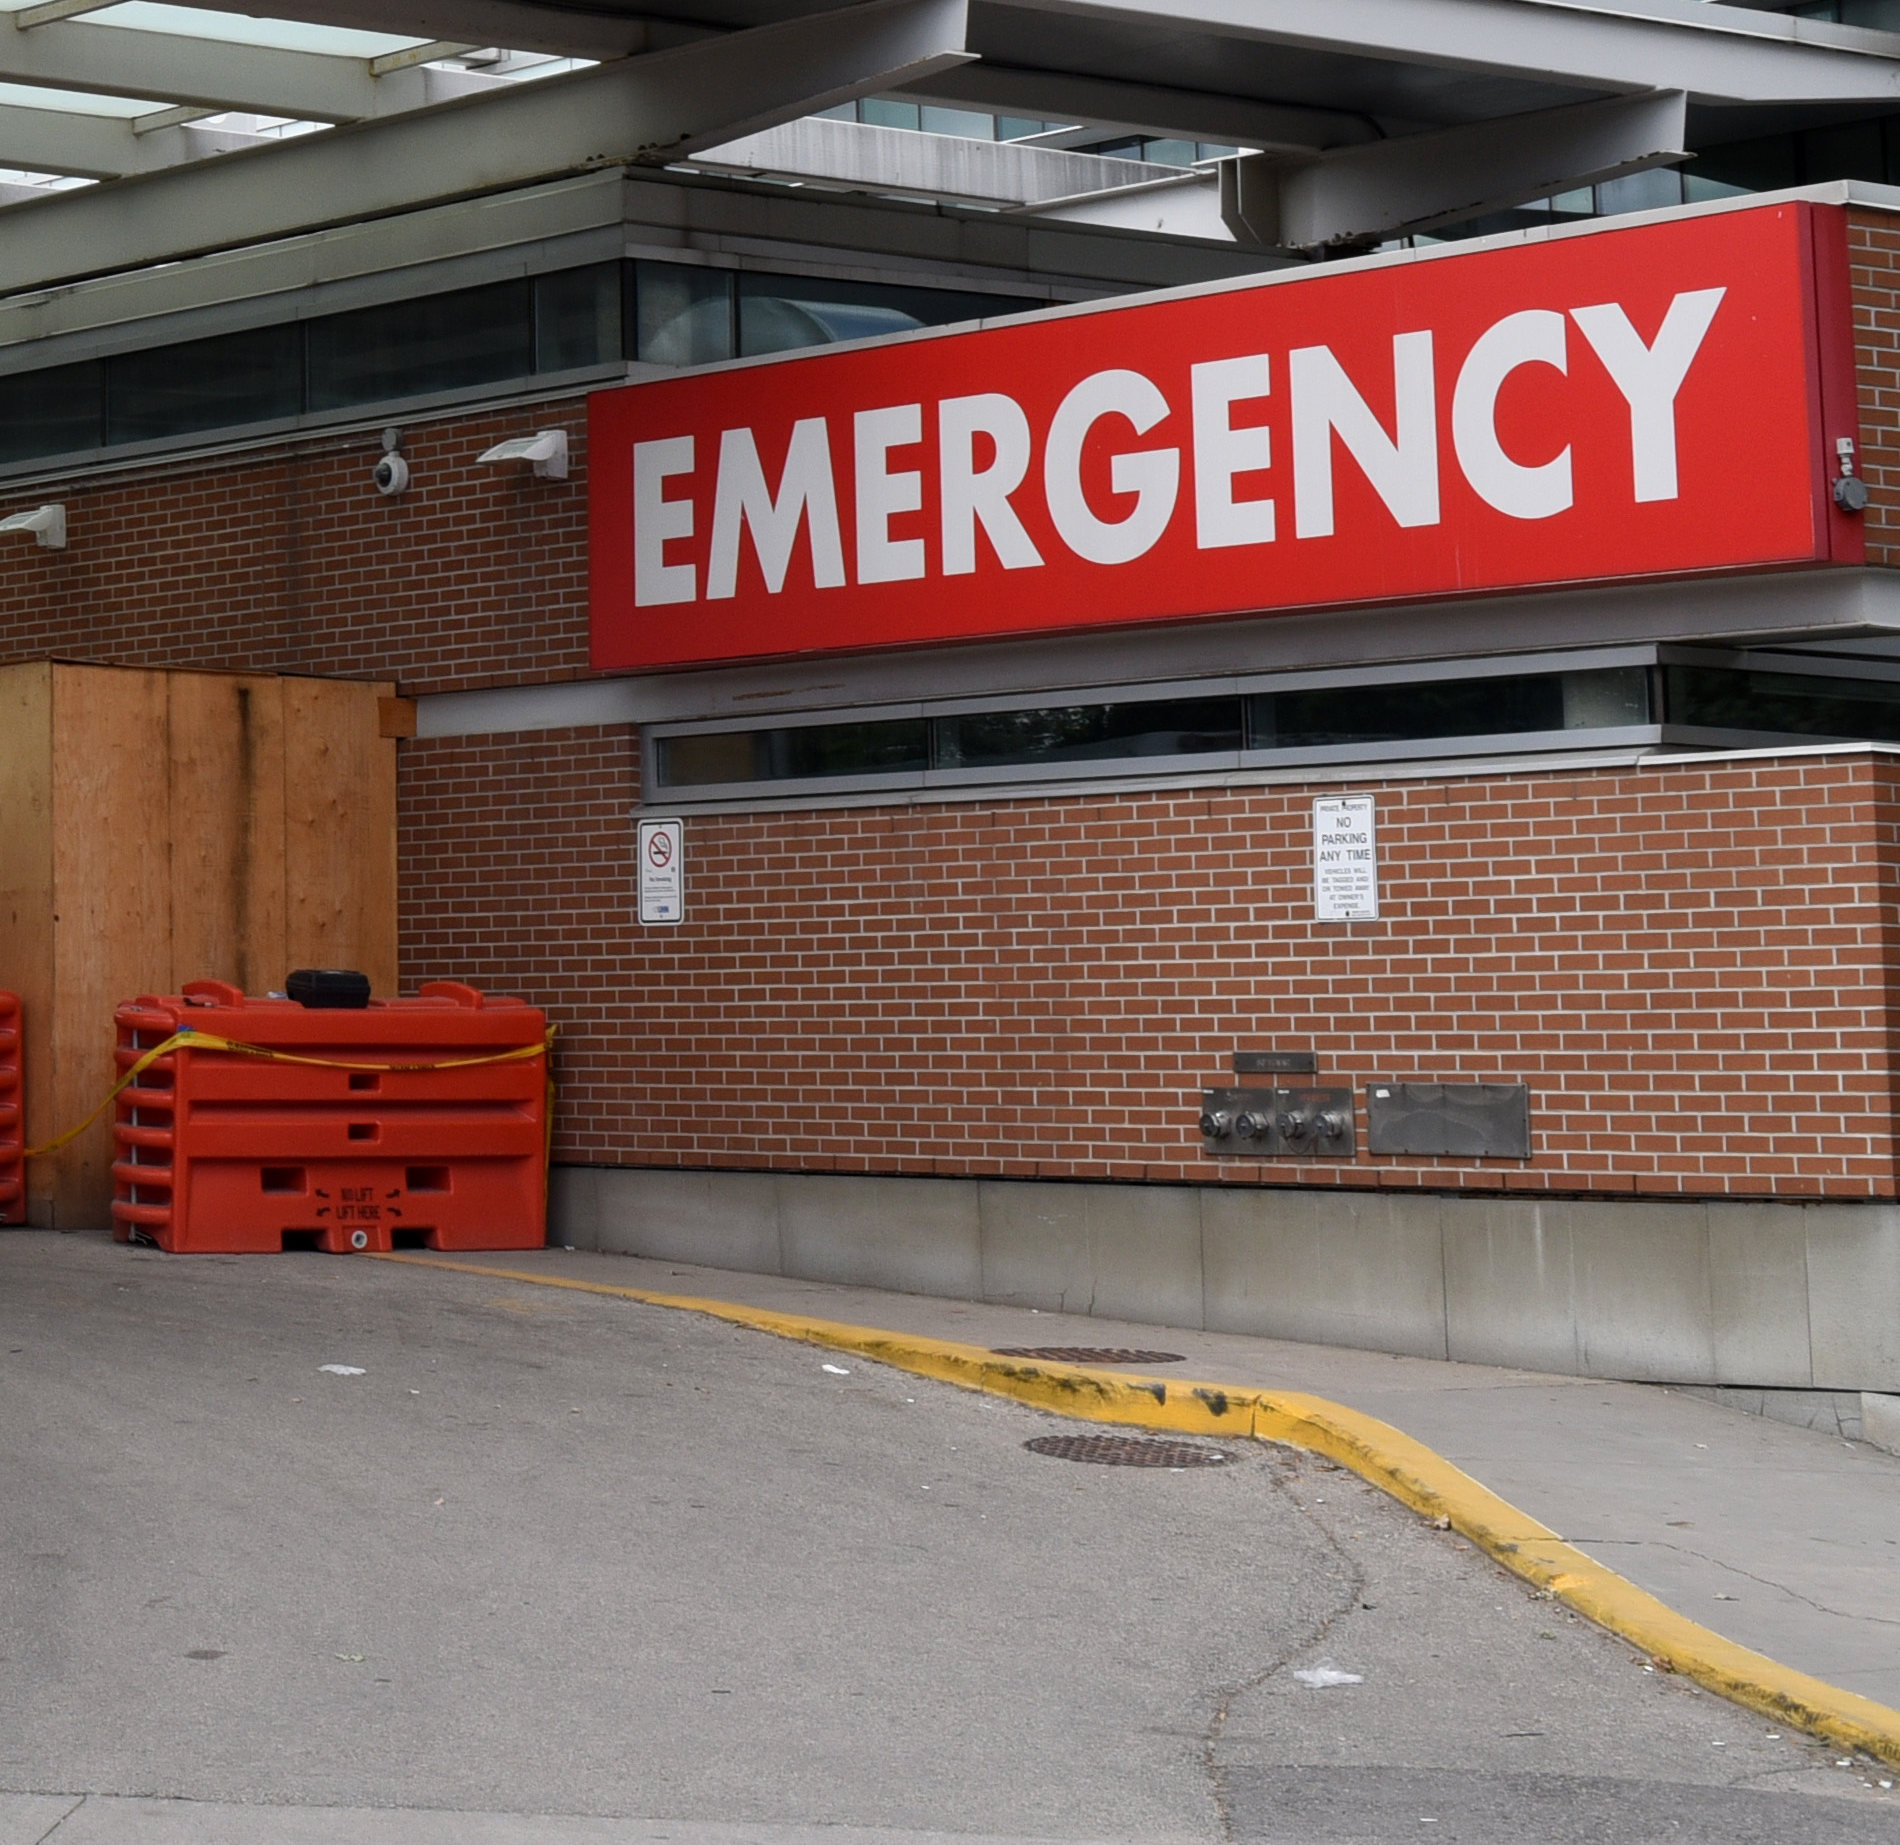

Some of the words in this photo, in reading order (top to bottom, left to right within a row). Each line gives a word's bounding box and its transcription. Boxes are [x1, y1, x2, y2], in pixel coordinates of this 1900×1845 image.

[632, 286, 1726, 608] EMERGENCY
[1336, 817, 1352, 828] NO
[1322, 833, 1367, 845] PARKING
[1320, 850, 1341, 862] ANY
[1346, 849, 1371, 860] TIME
